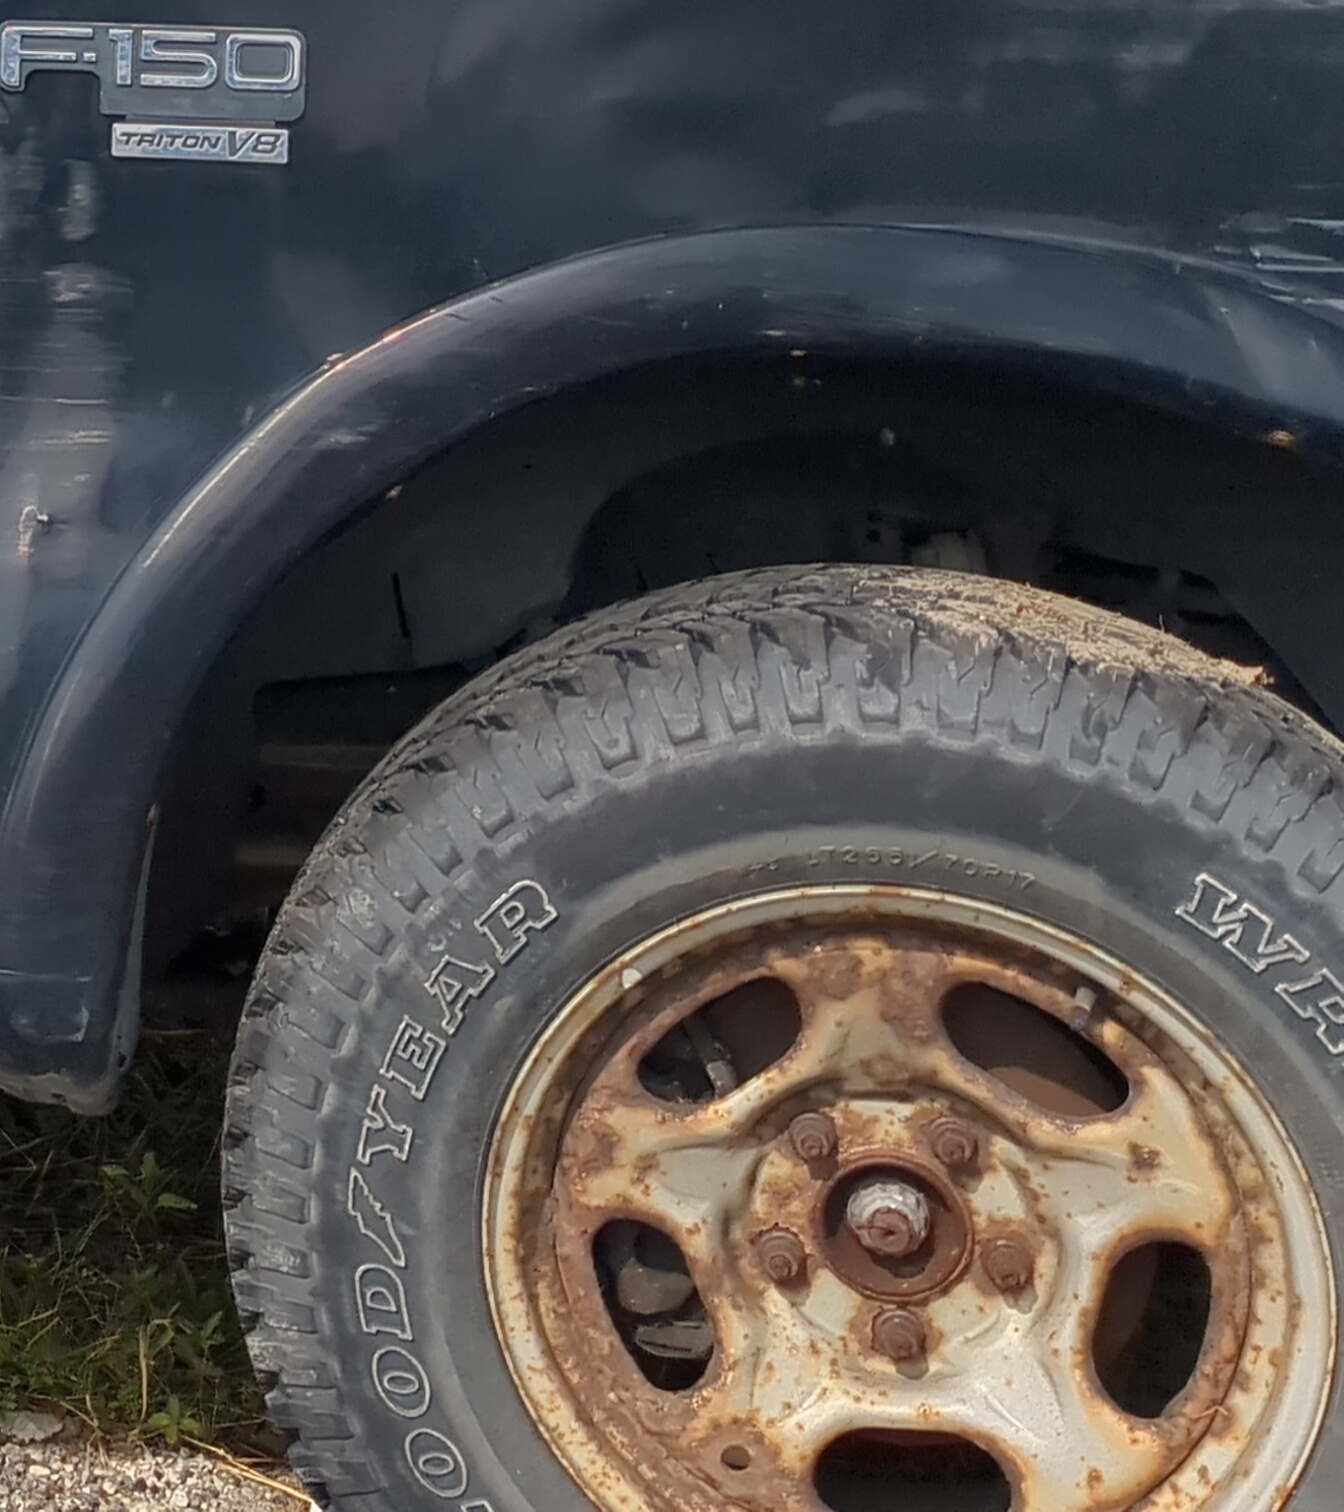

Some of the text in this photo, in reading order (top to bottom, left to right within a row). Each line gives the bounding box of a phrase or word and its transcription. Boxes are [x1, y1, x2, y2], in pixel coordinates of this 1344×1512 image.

[0, 25, 304, 91] F-150
[118, 129, 283, 161] TRITON V8
